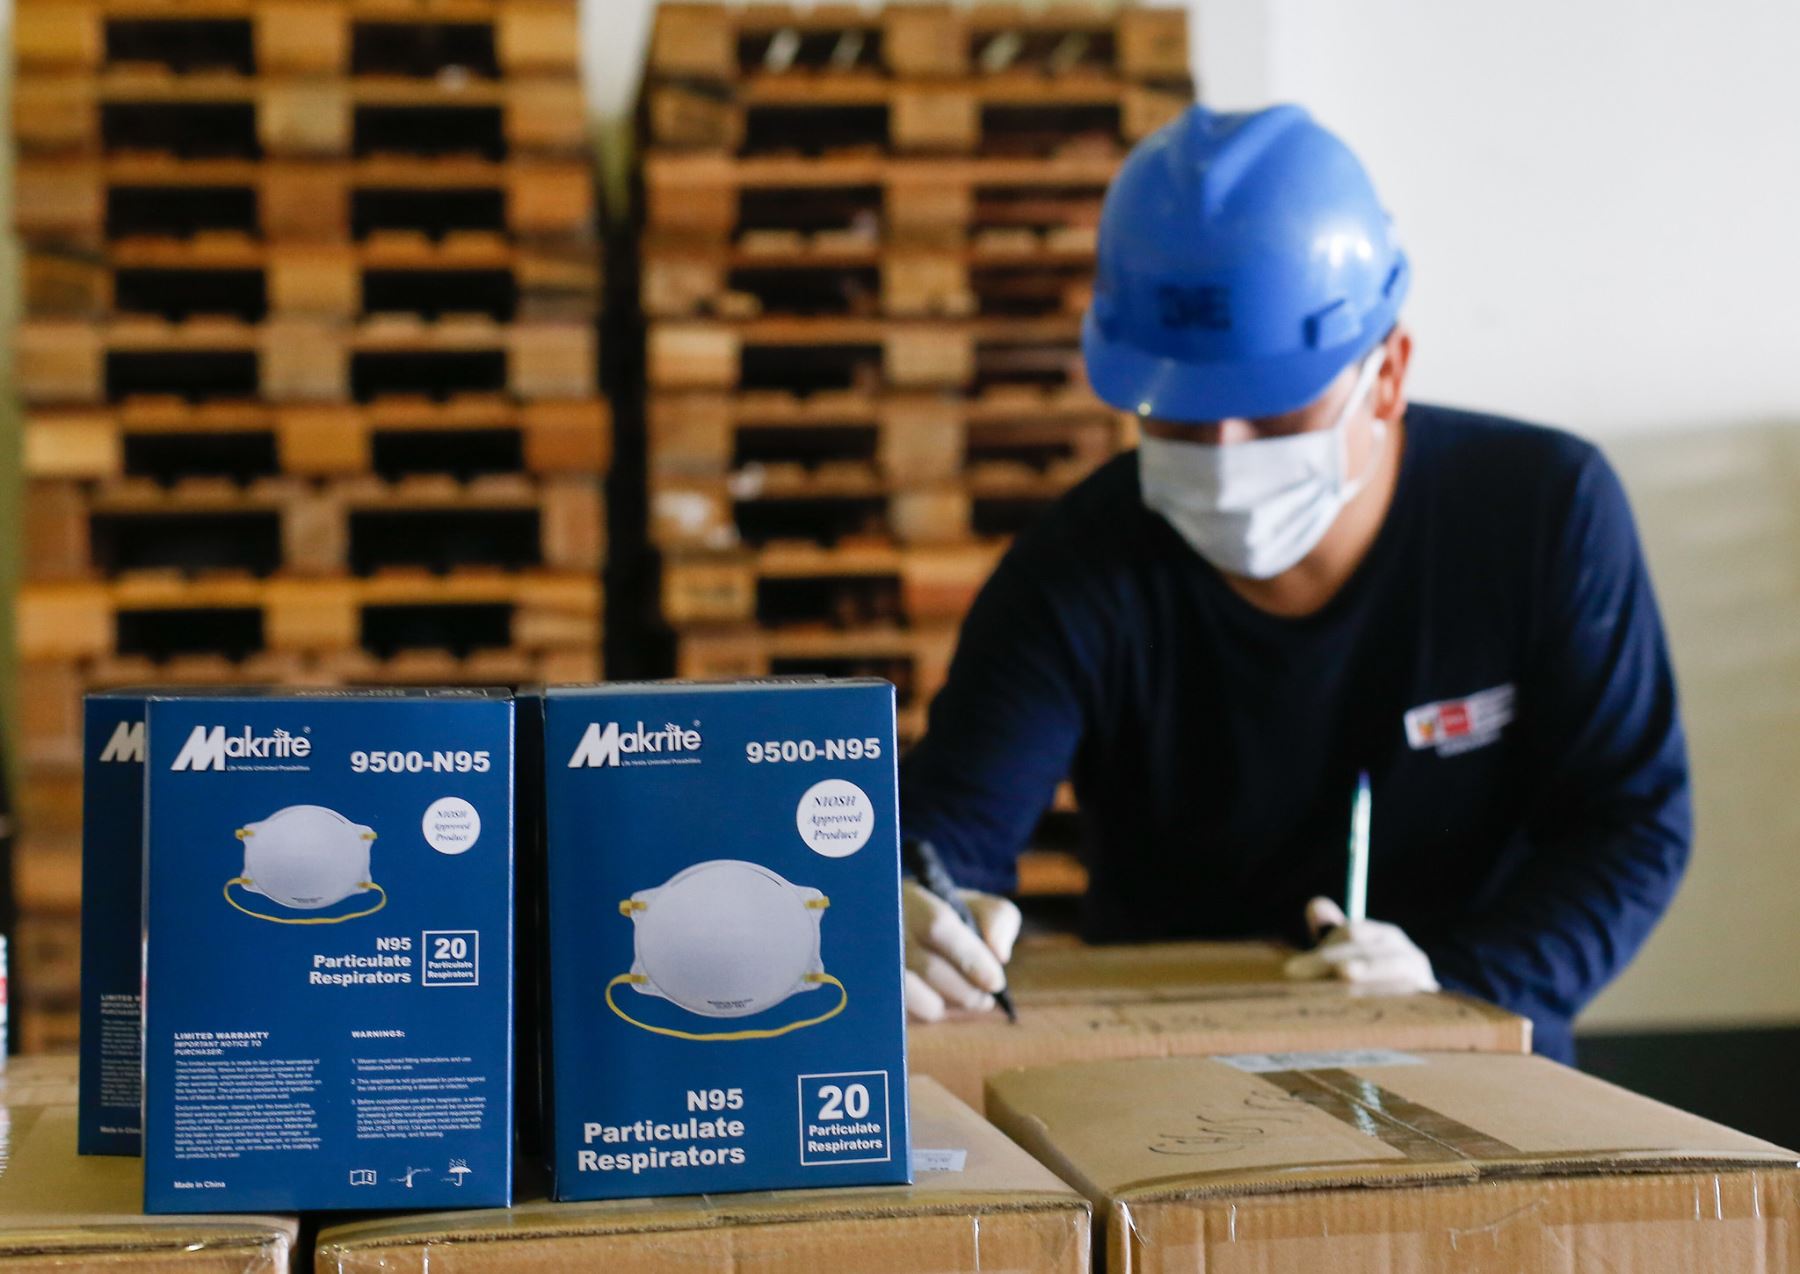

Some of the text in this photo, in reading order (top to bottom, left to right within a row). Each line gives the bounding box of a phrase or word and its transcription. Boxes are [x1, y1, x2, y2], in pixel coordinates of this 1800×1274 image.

[745, 738, 881, 764] 9500-N95
[350, 750, 491, 773] 9500-N95
[812, 794, 857, 808] NIOSH
[809, 810, 863, 827] Approved
[812, 827, 860, 842] Product
[376, 936, 412, 951] N95
[428, 937, 467, 960] 20
[313, 953, 412, 969] Particulate
[427, 959, 474, 970] Particulate
[309, 970, 412, 988] Respirators
[427, 969, 475, 980] Respirators
[174, 1031, 270, 1041] LIMITED WARRANTY
[351, 1029, 406, 1039] WARNINGS:
[687, 1088, 744, 1112] N95
[817, 1084, 871, 1121] 20
[583, 1119, 745, 1145] Particulate
[808, 1121, 882, 1136] Particulate
[807, 1137, 883, 1153] Respirators
[577, 1148, 746, 1174] Respirators
[173, 1181, 195, 1189] Made
[203, 1180, 226, 1189] China
